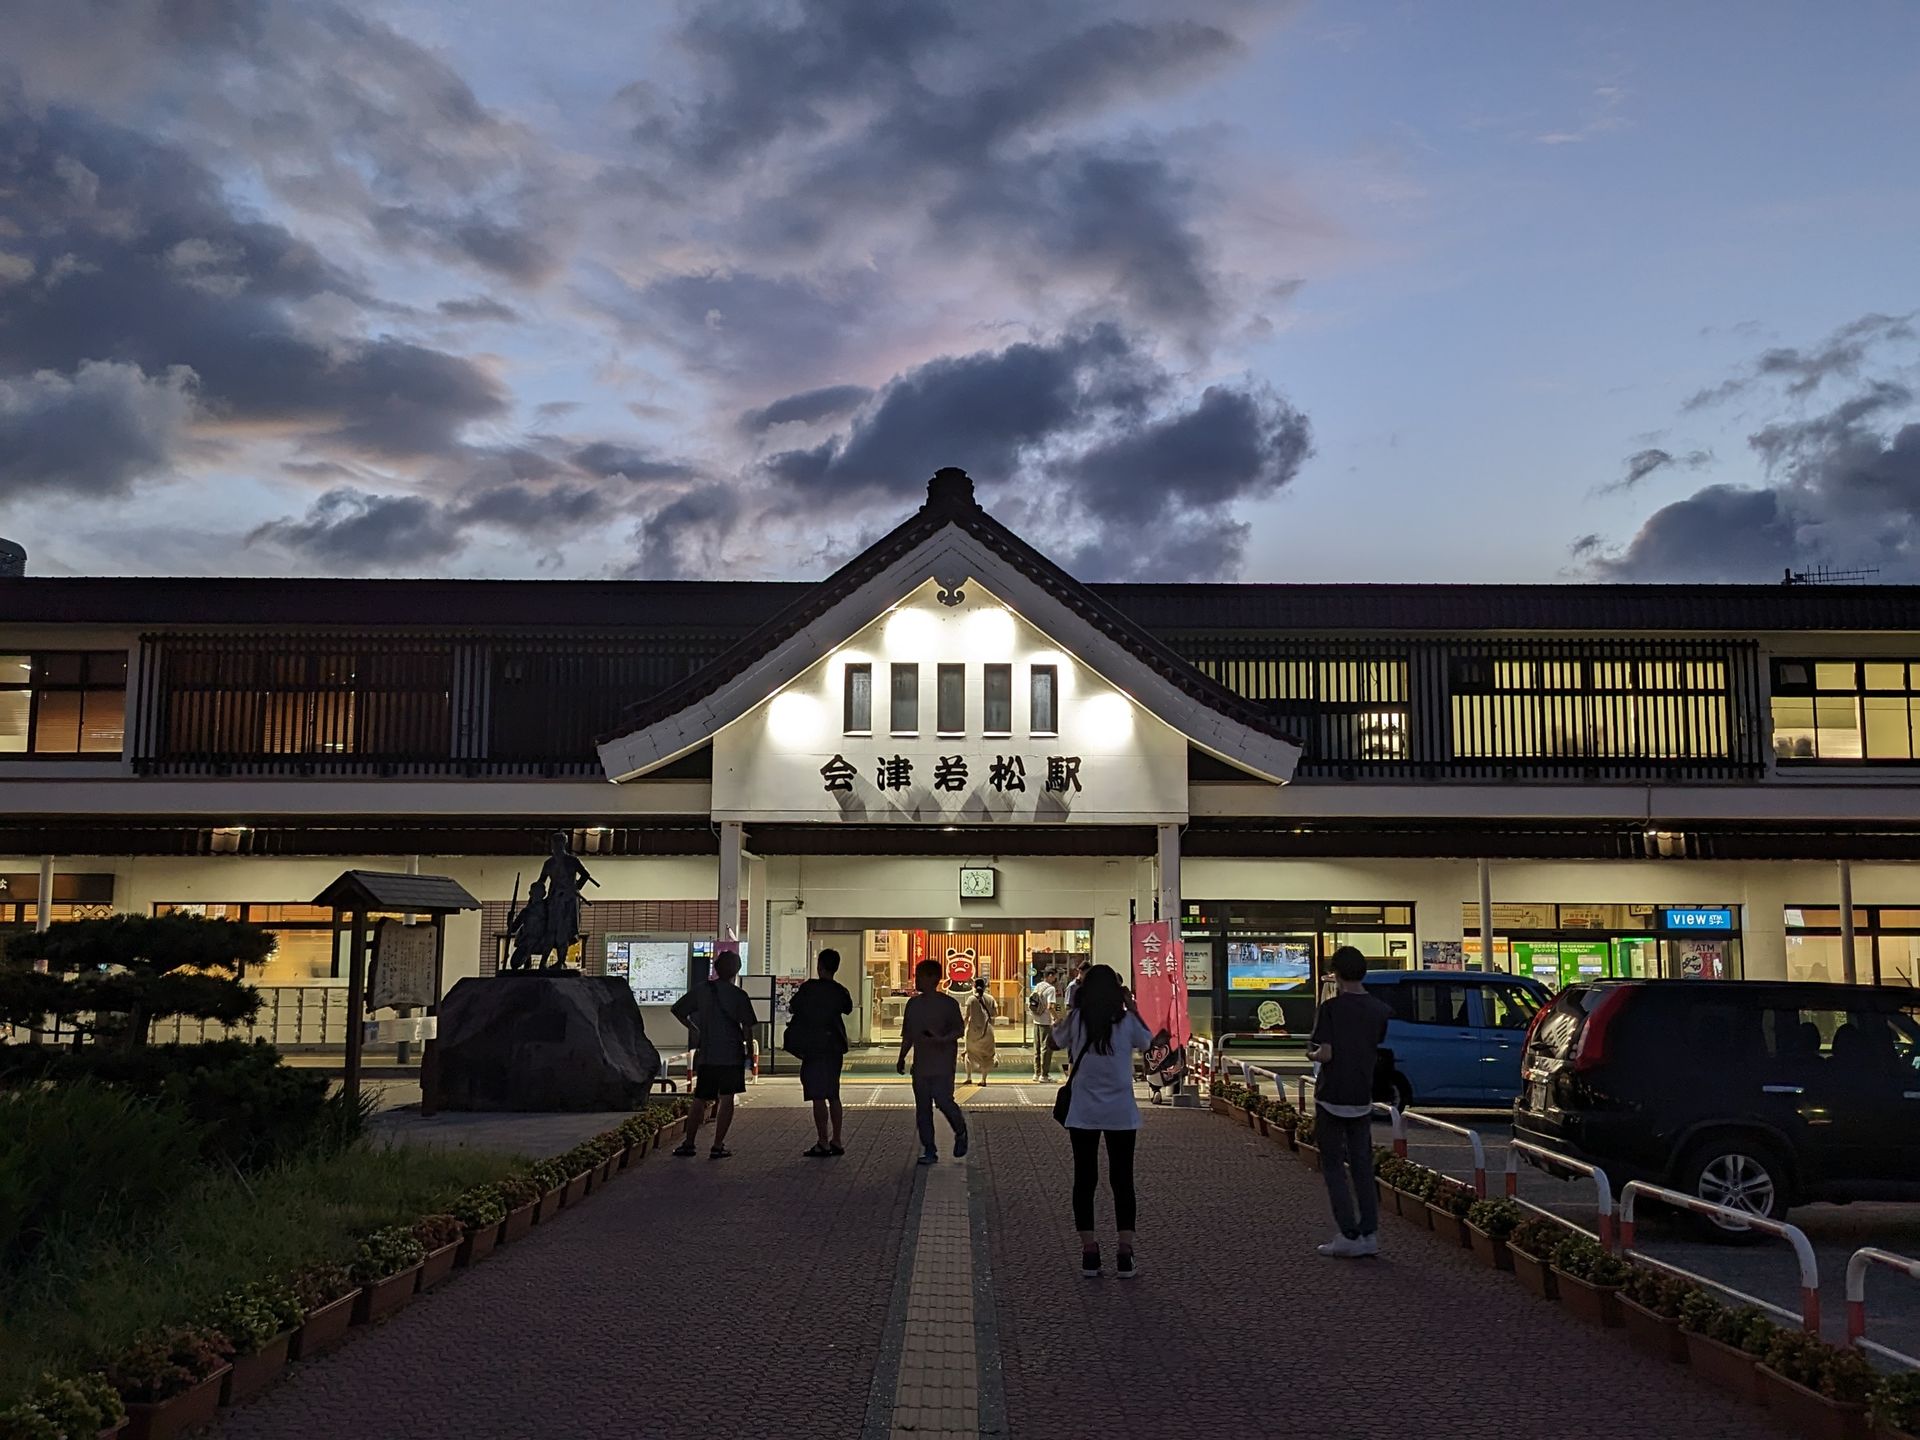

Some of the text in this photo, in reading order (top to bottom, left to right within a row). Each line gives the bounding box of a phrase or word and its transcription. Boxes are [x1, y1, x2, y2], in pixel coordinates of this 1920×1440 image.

[820, 754, 1082, 793] 会津若松駅
[1696, 944, 1715, 952] ATM
